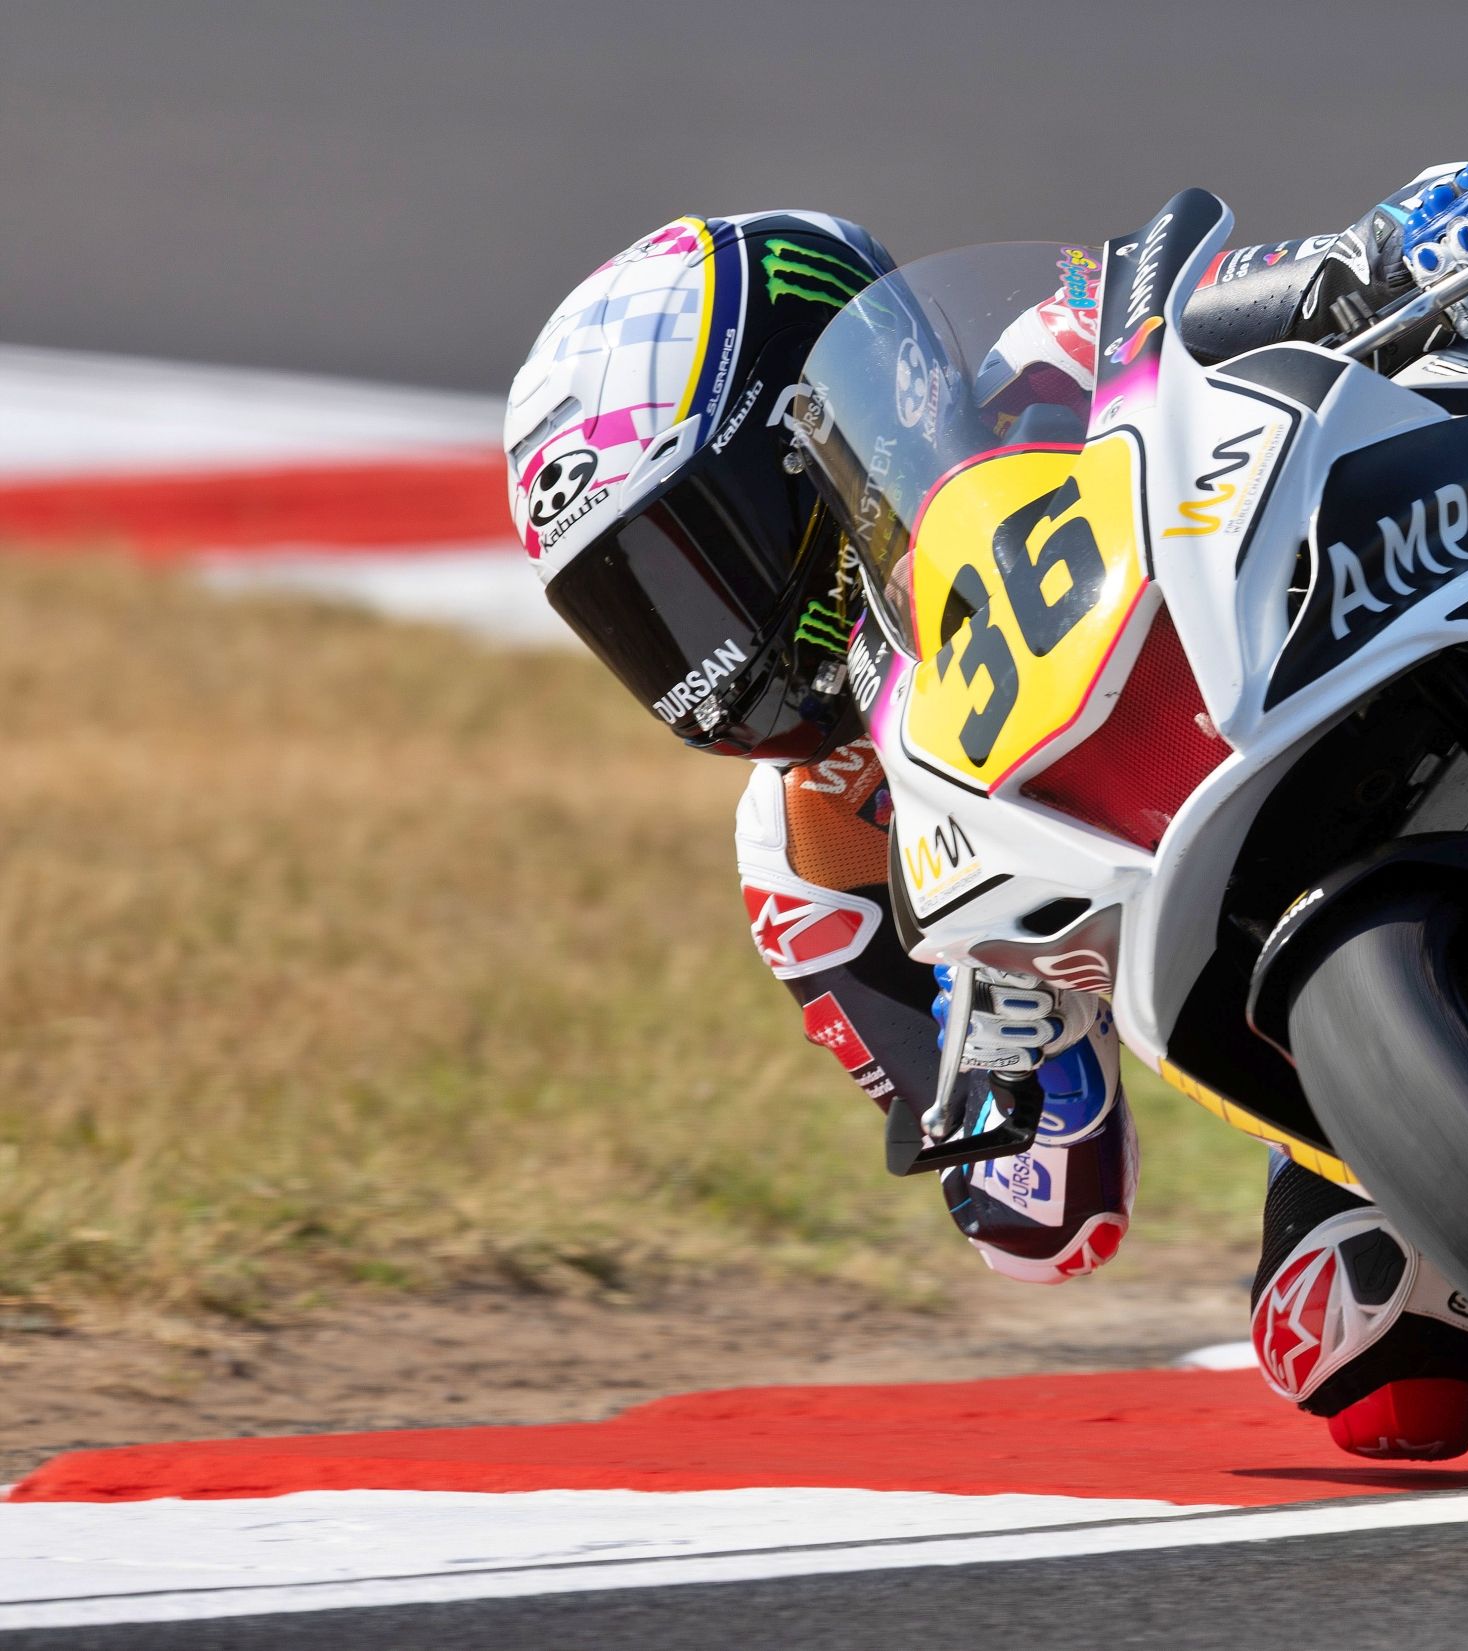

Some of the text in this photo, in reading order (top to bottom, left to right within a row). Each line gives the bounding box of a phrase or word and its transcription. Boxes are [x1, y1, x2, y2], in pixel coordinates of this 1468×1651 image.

[1125, 213, 1173, 328] AMPITO
[711, 379, 764, 455] Kabuto
[539, 486, 611, 554] Kabuto
[935, 475, 1106, 768] 36
[652, 638, 748, 726] DURSAN
[1011, 1152, 1032, 1209] DURSA
